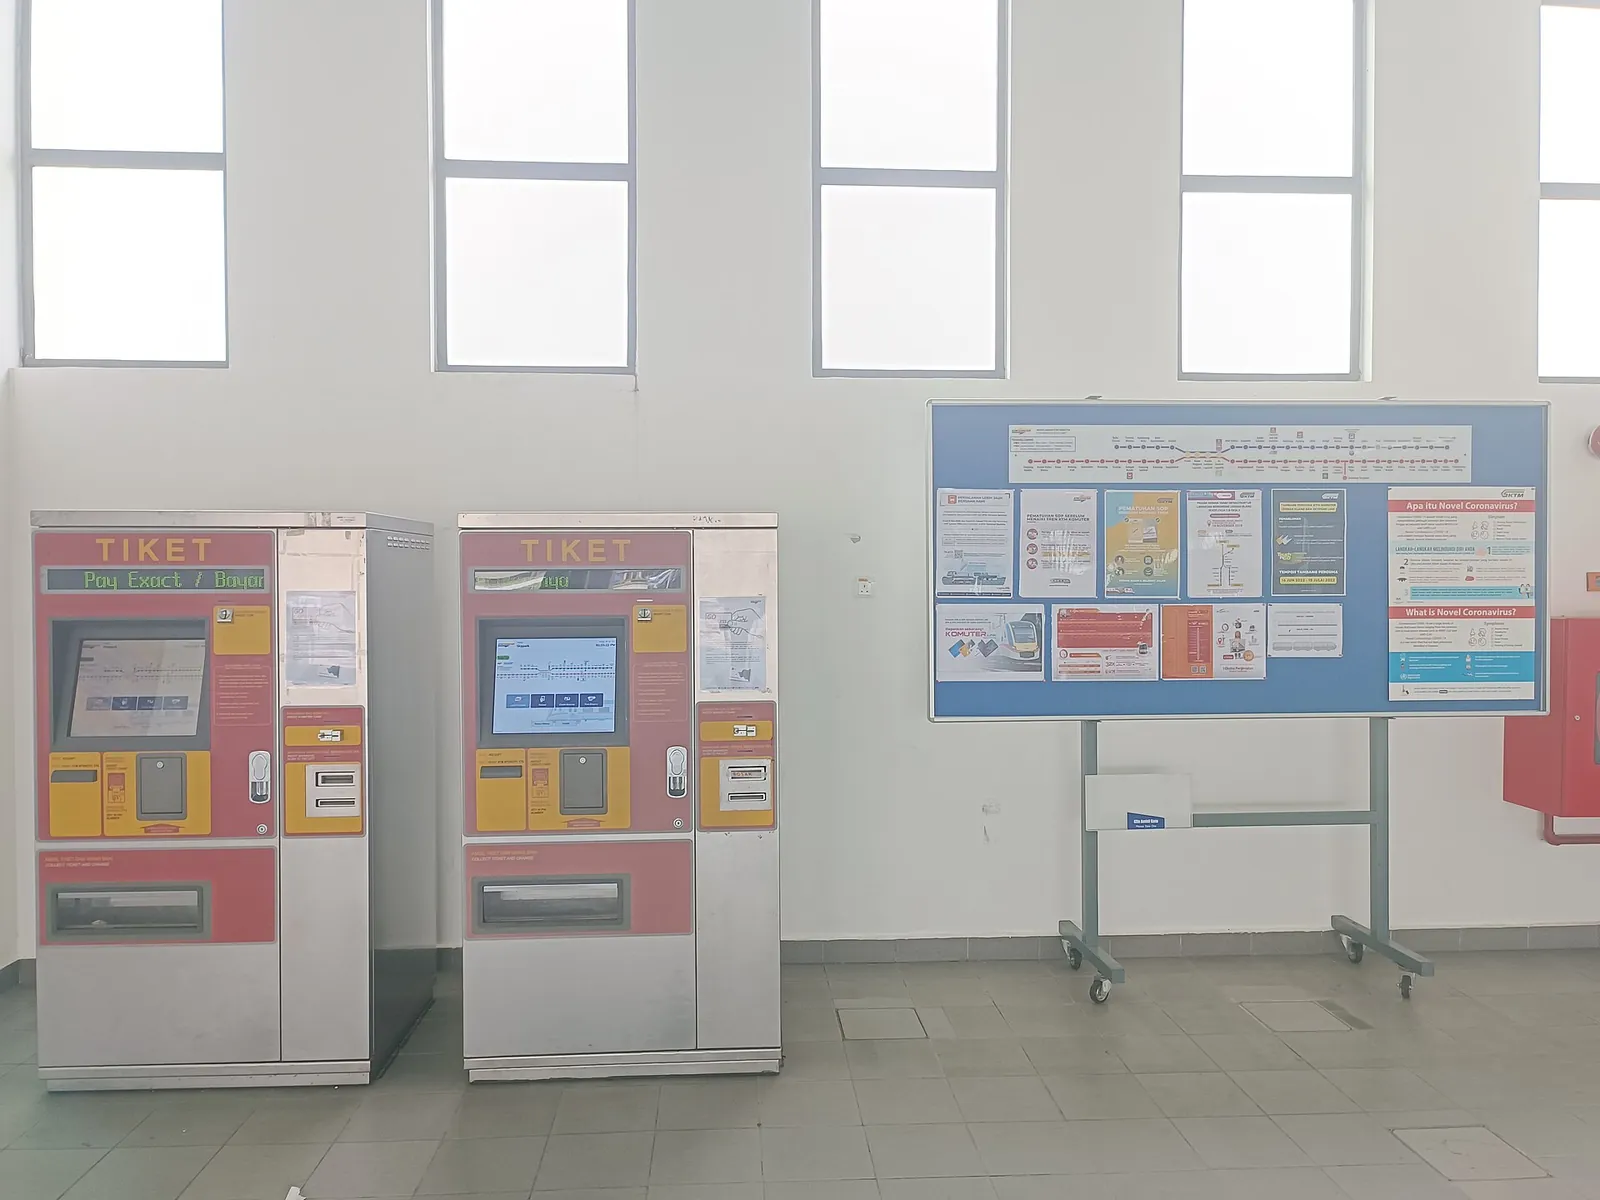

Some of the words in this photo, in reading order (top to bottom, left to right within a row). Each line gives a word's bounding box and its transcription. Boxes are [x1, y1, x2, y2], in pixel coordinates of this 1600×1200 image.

[1407, 502, 1423, 510] Apa
[1465, 502, 1517, 510] Coronavirus?
[96, 538, 212, 562] TIKET
[520, 539, 631, 562] TIKET
[84, 571, 118, 590] Pay
[128, 571, 182, 588] Exact
[1406, 608, 1427, 616] What
[1429, 608, 1435, 616] is
[1437, 608, 1461, 616] Novel
[1463, 608, 1517, 616] Coronavirus?
